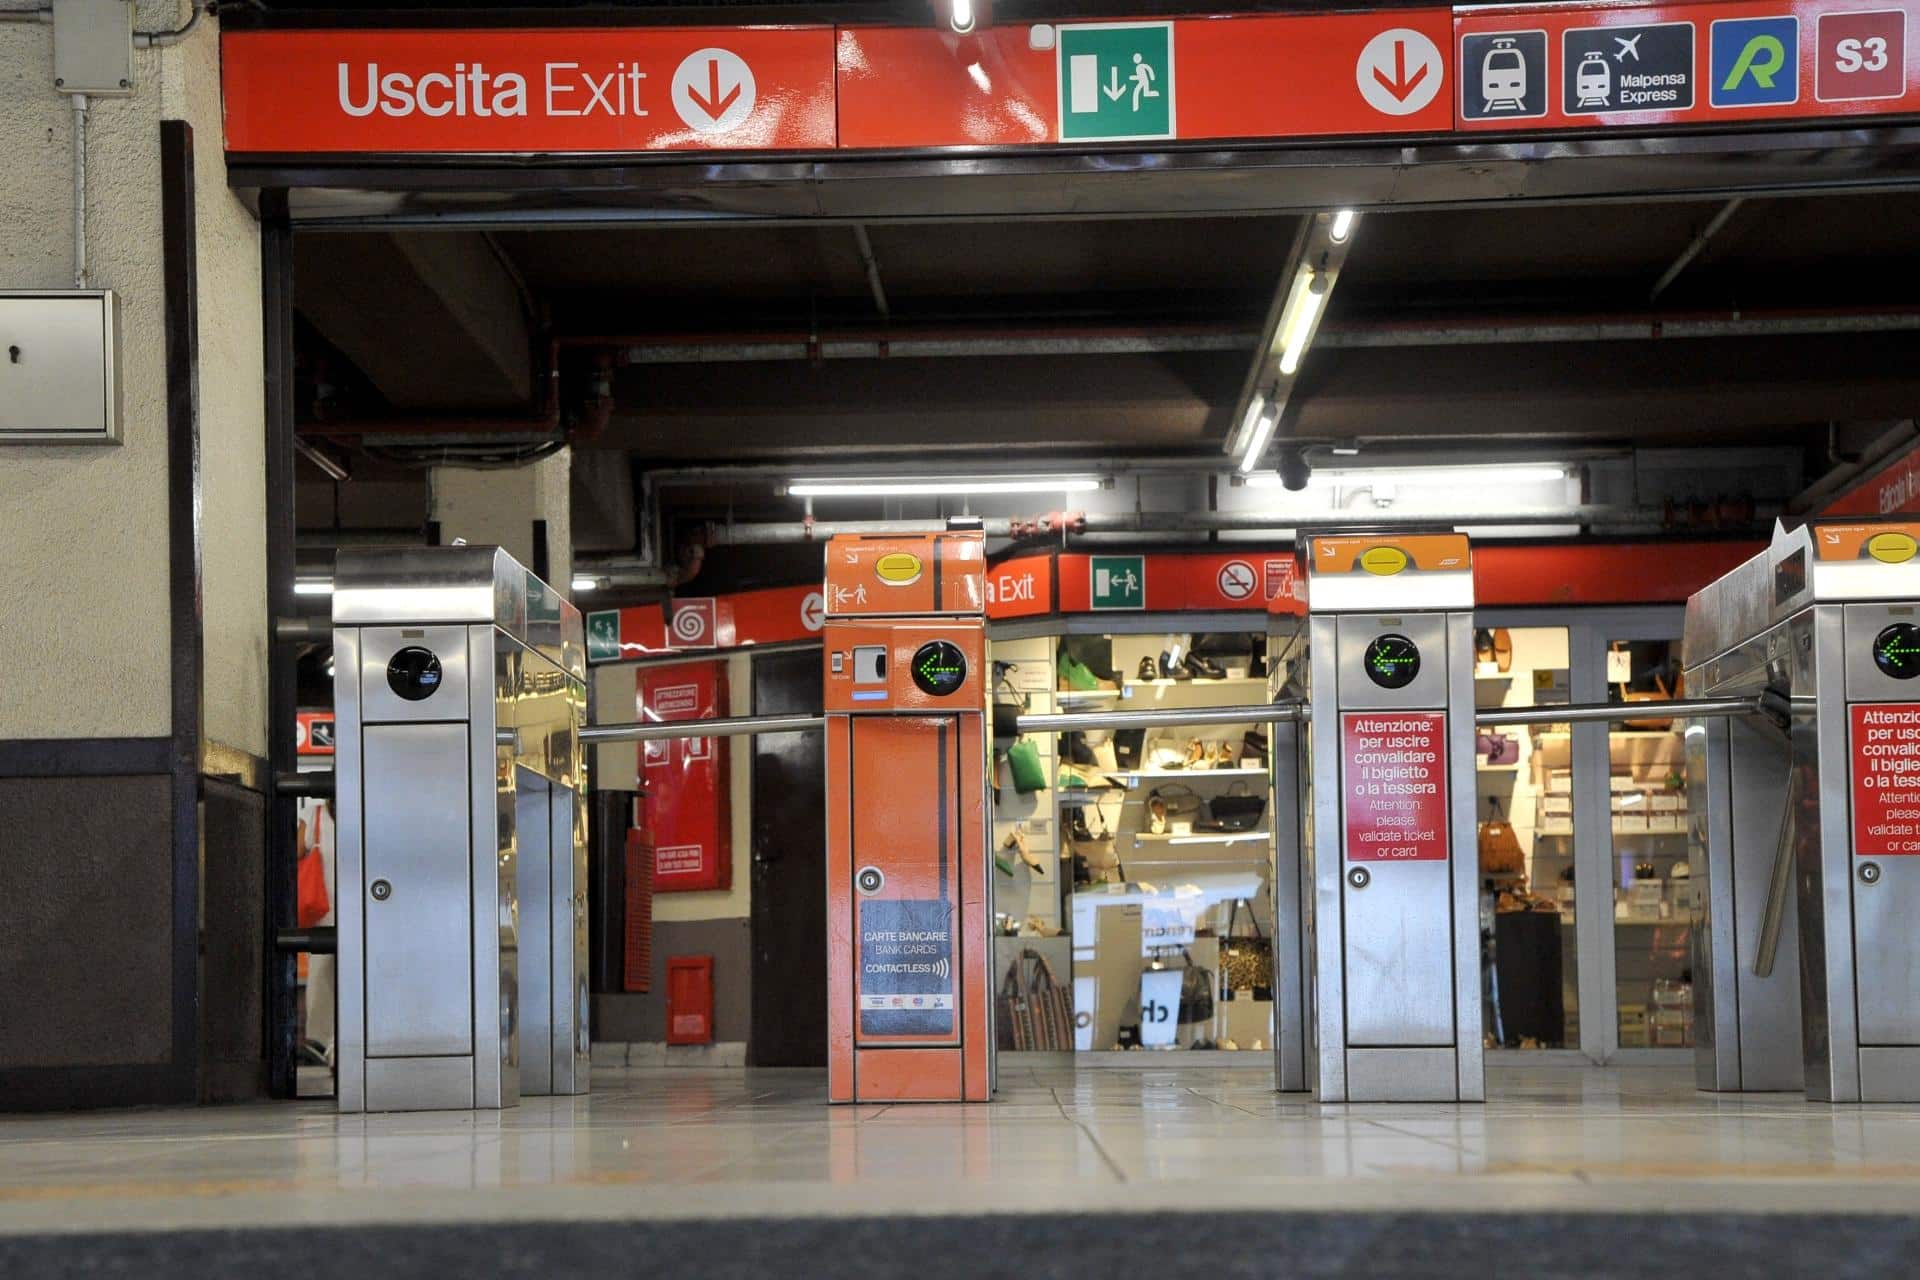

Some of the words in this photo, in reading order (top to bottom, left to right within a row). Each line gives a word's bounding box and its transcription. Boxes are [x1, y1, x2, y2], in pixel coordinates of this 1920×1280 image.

[1835, 37, 1888, 73] S3
[1620, 73, 1686, 88] Malpensa
[337, 63, 527, 117] Uscita
[546, 62, 648, 117] Exit
[1620, 89, 1677, 104] Express
[999, 574, 1036, 602] Exit
[1355, 720, 1433, 733] Attenzione:
[1868, 729, 1894, 742] per
[1360, 737, 1384, 750] per
[1387, 735, 1430, 748] uscire
[1355, 751, 1436, 764] convalidare
[1371, 765, 1429, 781] biglietto
[1863, 776, 1874, 788] o
[1877, 775, 1889, 788] la
[1355, 784, 1366, 796] o
[1368, 782, 1380, 795] la
[1383, 781, 1437, 794] tessera
[1370, 799, 1424, 812] Attention:
[1359, 830, 1402, 842] validate
[1404, 829, 1435, 842] ticket
[1867, 824, 1913, 836] validate
[1377, 847, 1389, 857] or
[1391, 846, 1418, 857] card
[1887, 841, 1900, 852] or
[864, 931, 897, 942] CARTE
[899, 931, 949, 942] BANCARIE
[875, 944, 901, 955] BANK
[903, 943, 938, 954] CARDS
[865, 963, 931, 974] CONTACTLESS
